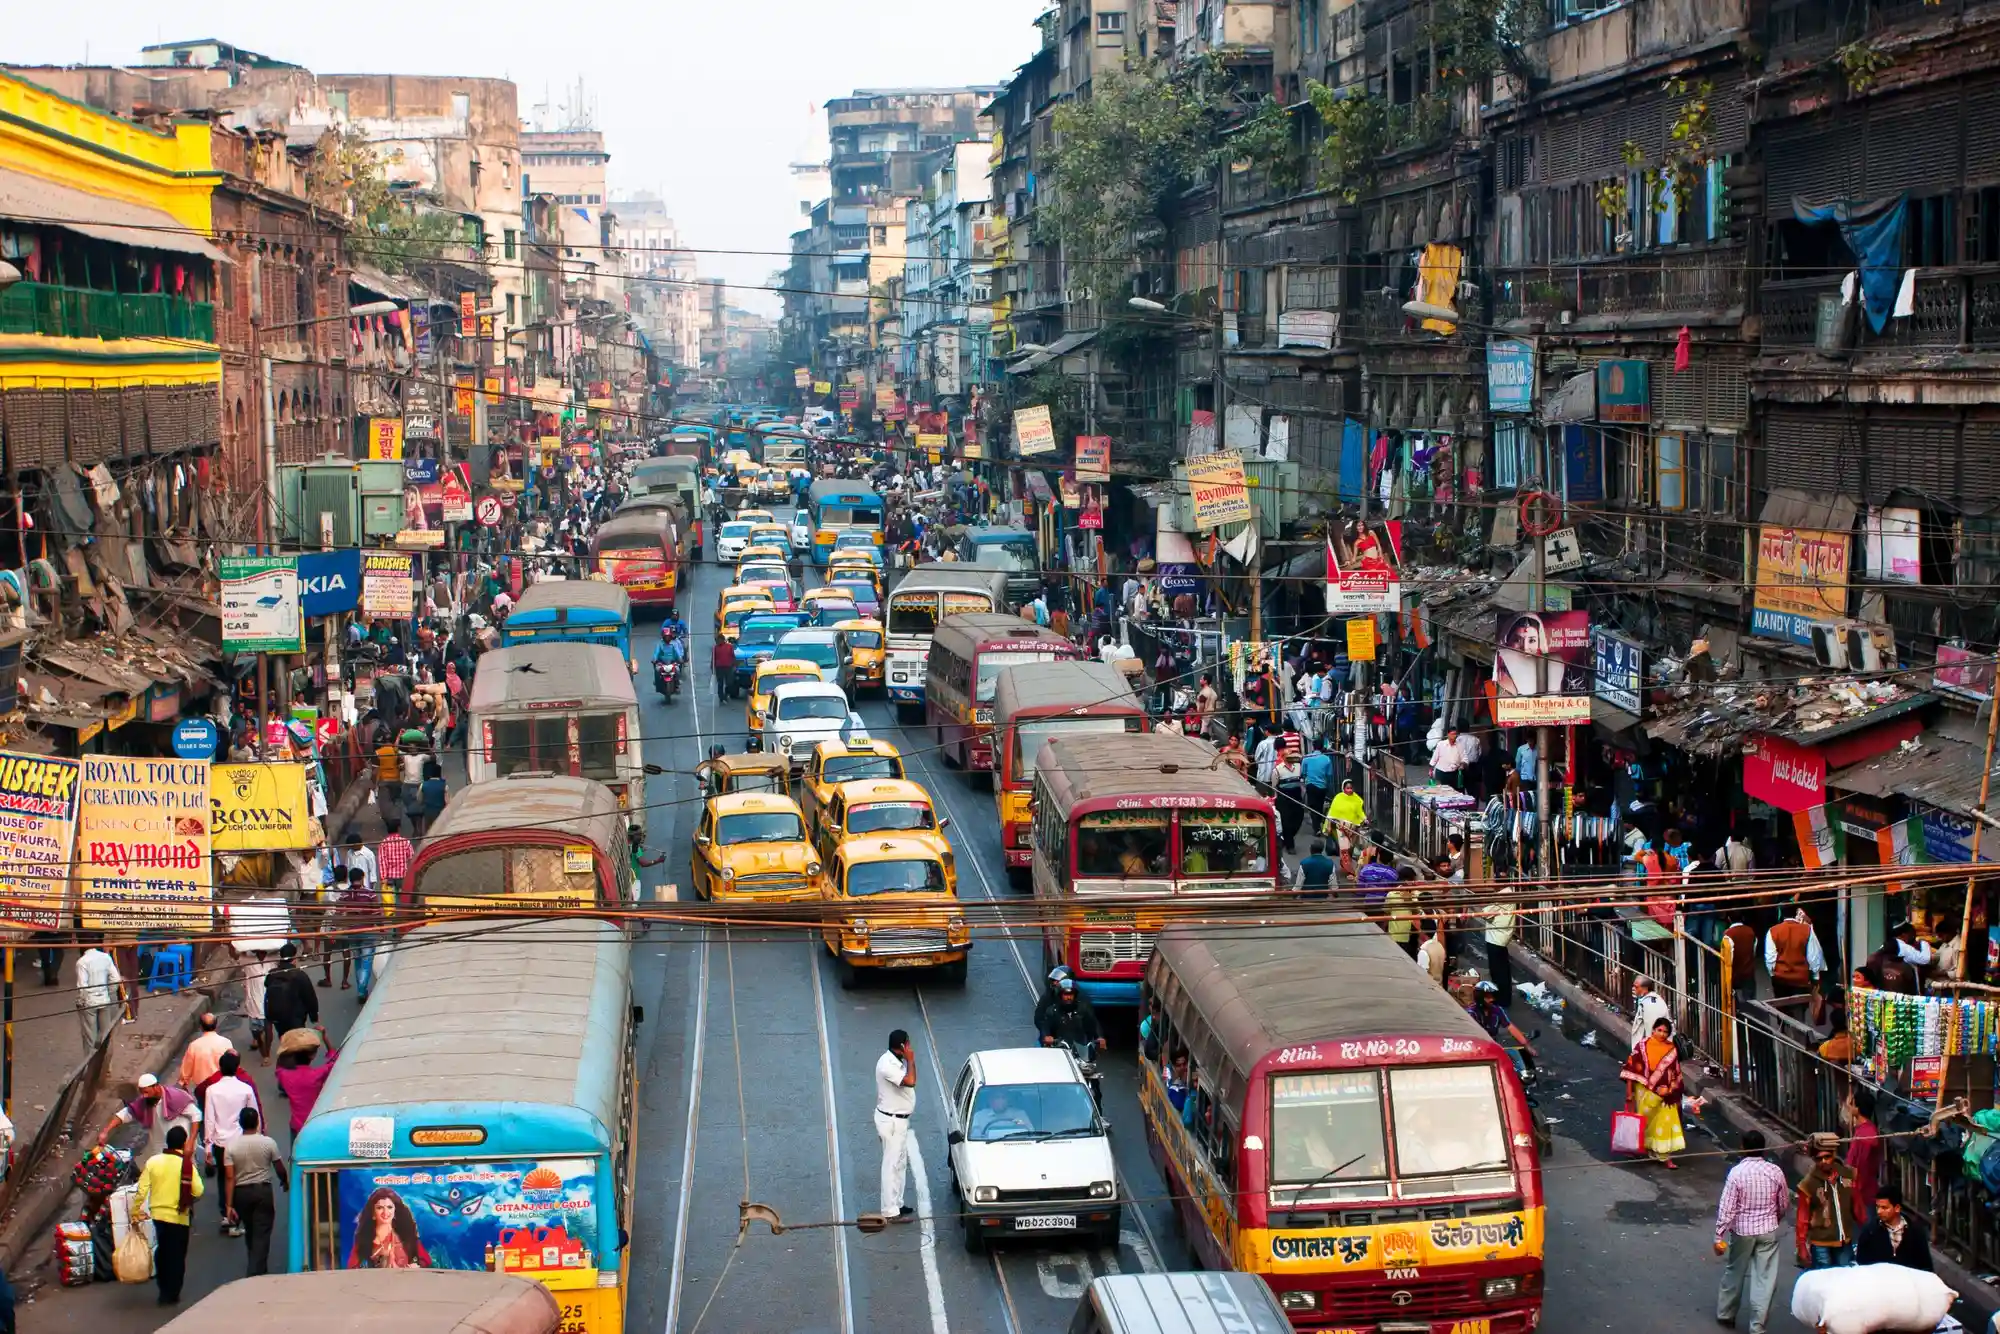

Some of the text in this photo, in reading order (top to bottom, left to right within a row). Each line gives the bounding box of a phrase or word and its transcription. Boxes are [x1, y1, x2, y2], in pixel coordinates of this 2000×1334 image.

[1196, 481, 1244, 503] Raymond
[365, 556, 412, 570] ABHISHEK
[1161, 576, 1196, 588] CROWN
[1341, 572, 1385, 587] Ashok
[1754, 611, 1791, 632] NANDY
[1566, 700, 1573, 708] &
[1612, 693, 1637, 708] STORES
[85, 761, 206, 786] ROYAL TOUCH
[1772, 753, 1819, 792] just baked
[237, 784, 248, 798] C
[84, 788, 158, 807] CREATIONS
[161, 791, 179, 809] (P)
[1214, 798, 1237, 808] Bus
[85, 816, 130, 831] LINEN
[210, 798, 293, 835] CROWN
[28, 820, 43, 831] OF
[228, 822, 293, 832] SCHOOL UNIFORM
[19, 833, 61, 850] KURTA,
[14, 848, 60, 863] BLAZAR
[90, 839, 201, 876] Raymond
[27, 864, 63, 878] DRESS
[20, 878, 50, 892] Street
[92, 878, 198, 892] ETHNIC WEAR &
[495, 1200, 591, 1213] GITANJALI GOLD
[1383, 1267, 1420, 1280] TATA
